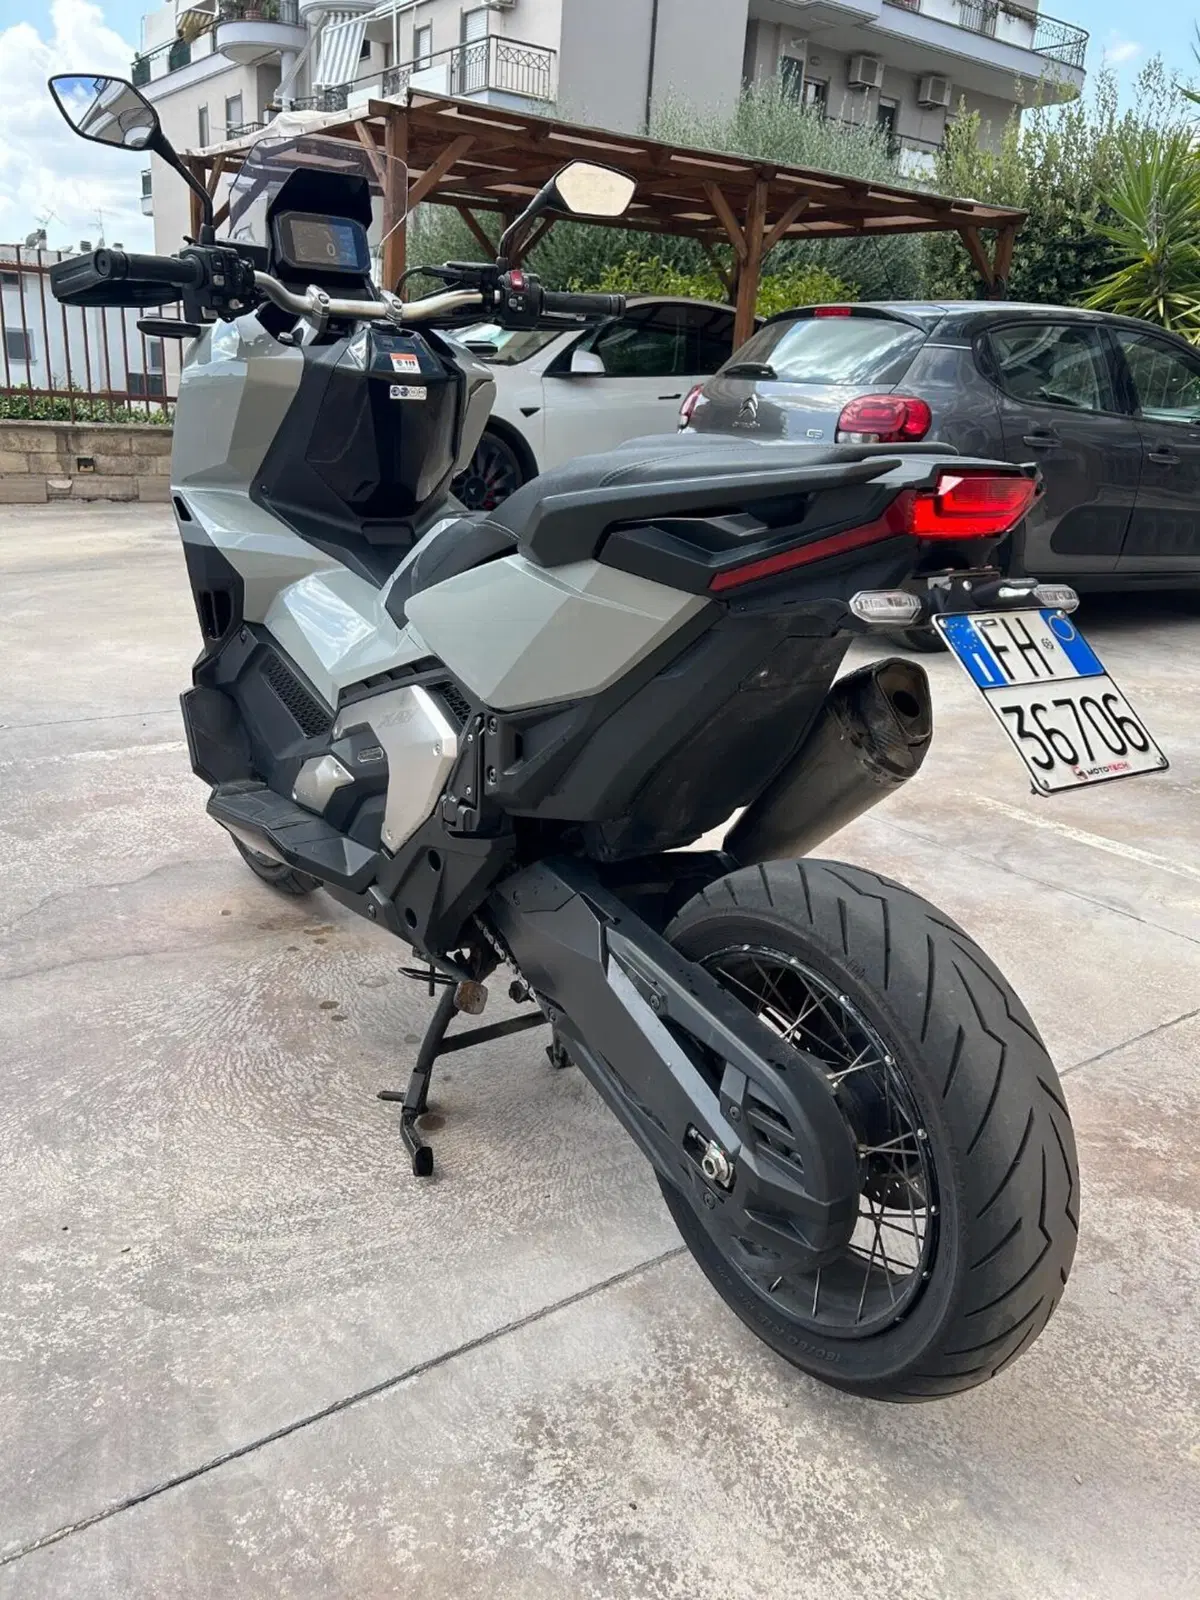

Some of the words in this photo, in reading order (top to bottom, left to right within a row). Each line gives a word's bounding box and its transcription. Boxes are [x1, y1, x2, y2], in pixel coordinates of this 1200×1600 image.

[975, 617, 1054, 680] FH
[1000, 693, 1150, 770] 36706
[1086, 761, 1130, 776] MOTOTECH
